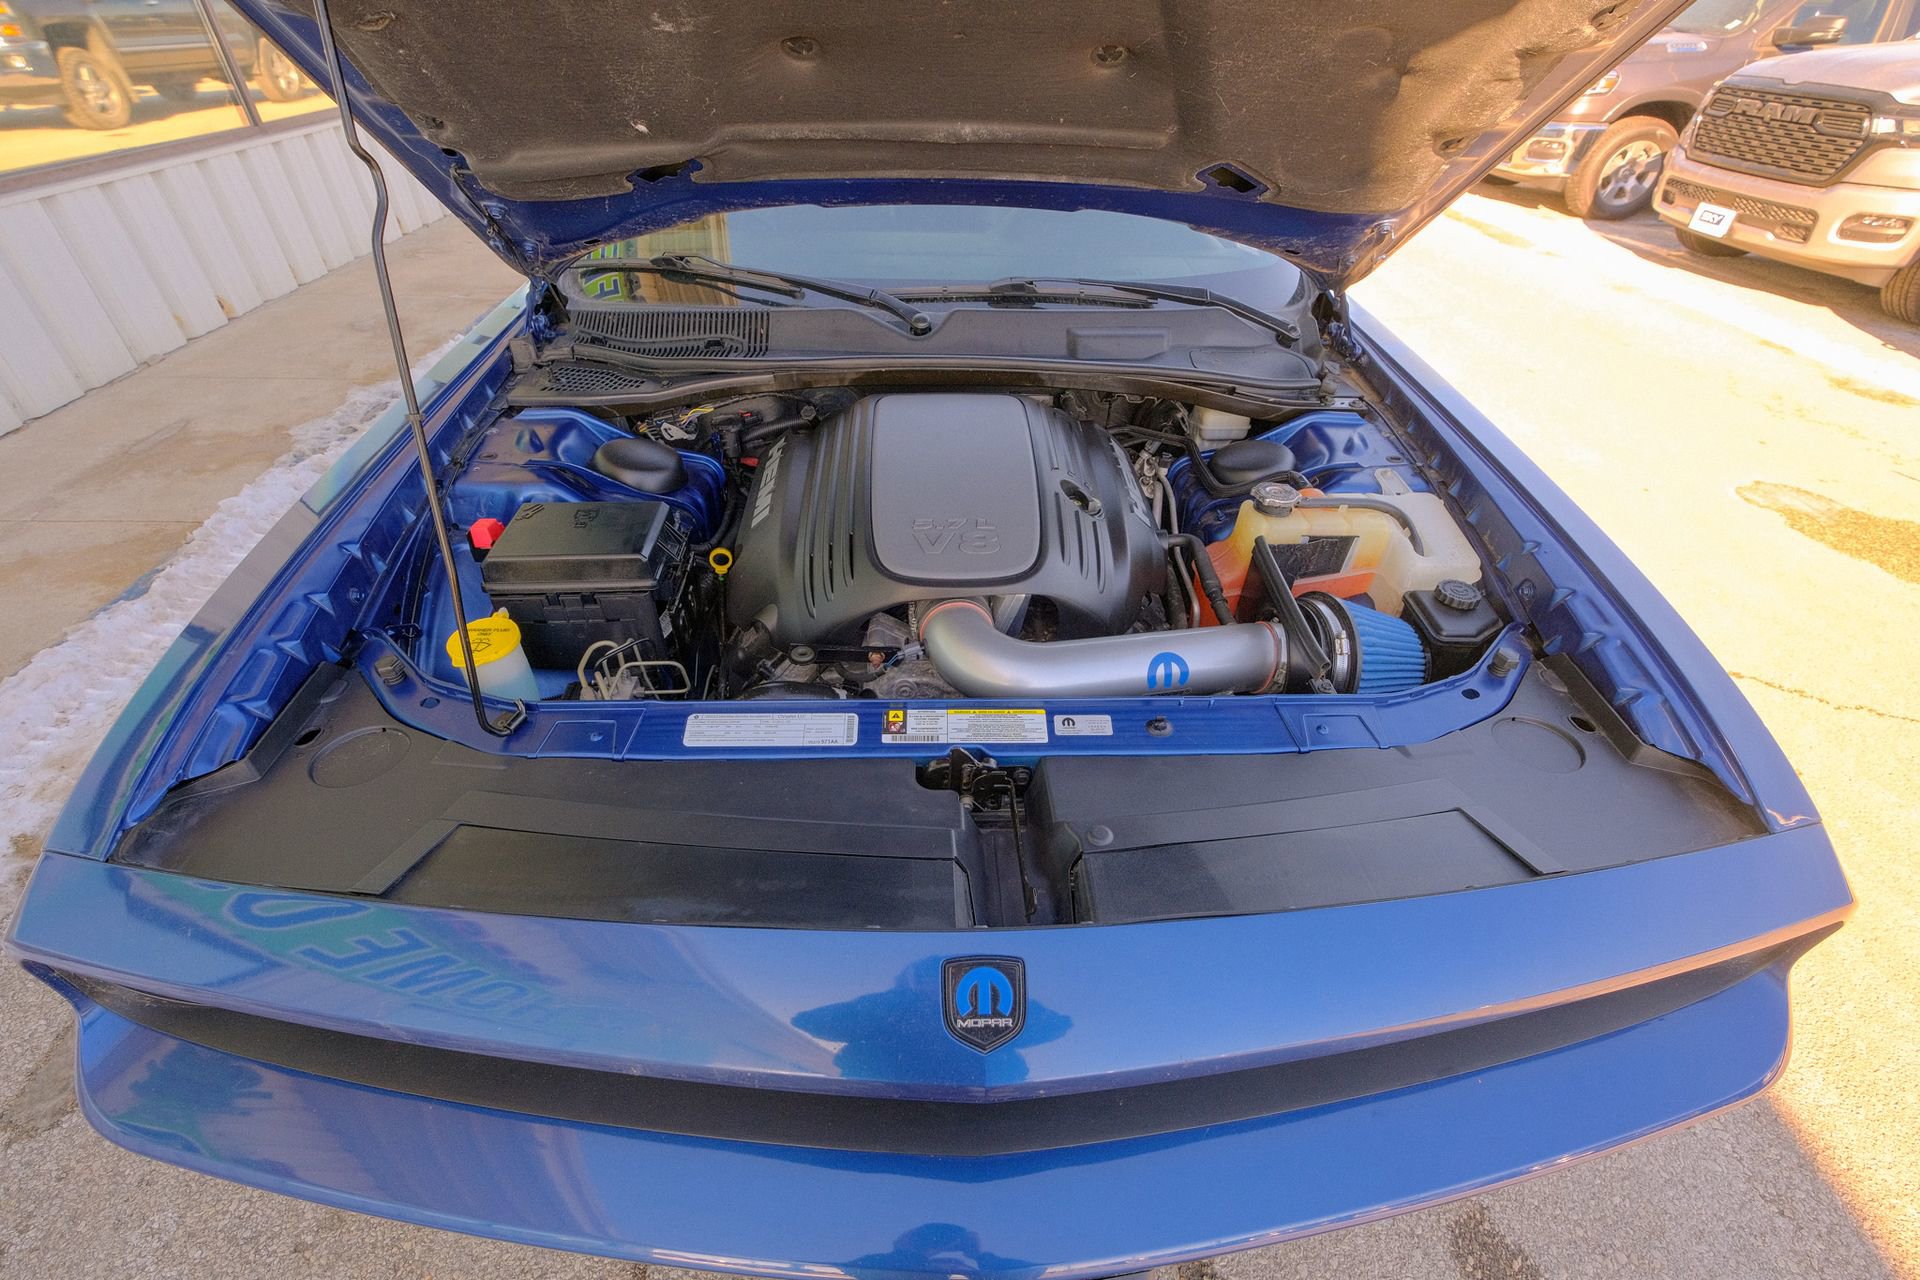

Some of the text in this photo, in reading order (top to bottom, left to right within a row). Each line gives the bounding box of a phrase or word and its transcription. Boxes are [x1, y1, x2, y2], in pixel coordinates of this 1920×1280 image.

[1734, 98, 1820, 125] RAM
[751, 436, 787, 529] HEMI
[912, 518, 997, 530] 5.7 L
[912, 531, 1002, 555] V8
[956, 1018, 1013, 1028] MOPAR
